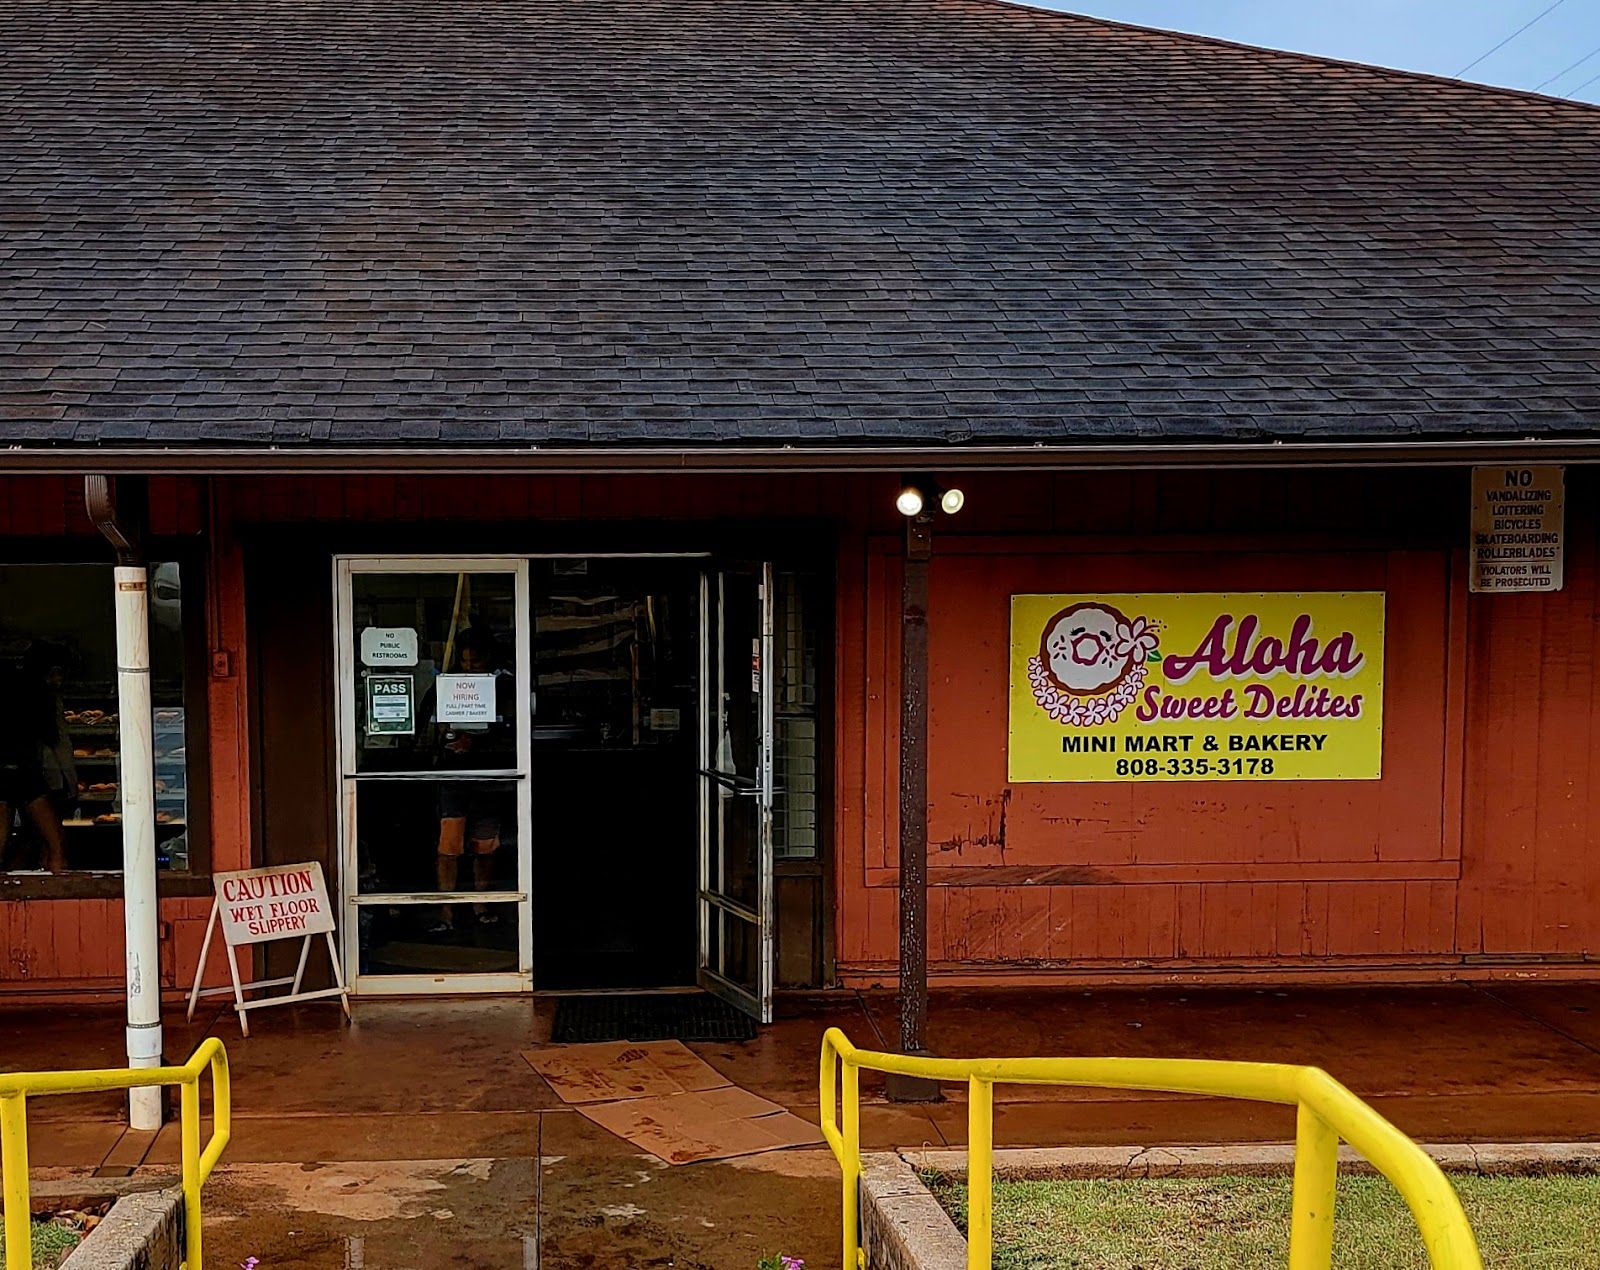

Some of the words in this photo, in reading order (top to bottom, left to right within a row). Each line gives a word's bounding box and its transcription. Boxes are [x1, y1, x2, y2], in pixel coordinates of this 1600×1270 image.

[1505, 469, 1533, 487] NO
[1486, 490, 1552, 502] VANDALIZING
[1492, 505, 1544, 516] LOITERING
[1494, 519, 1541, 530] BICYCLES
[1475, 533, 1559, 545] SKATEBOARDING
[1477, 547, 1556, 559] ROLLERBLADES
[1480, 565, 1528, 576] VIOLATORS
[1531, 565, 1552, 575] WILL
[1480, 578, 1492, 588] BE
[1495, 577, 1551, 587] PROSECUTED
[1162, 613, 1365, 680] Aloha
[374, 683, 407, 694] PASS
[453, 693, 480, 701] HIRING
[1136, 685, 1239, 722] Sweet
[1243, 683, 1363, 720] Delites
[1062, 735, 1116, 753] MINI
[1124, 735, 1194, 752] MART
[1202, 735, 1220, 752] &
[1228, 734, 1328, 752] BAKERY
[1115, 758, 1275, 776] 808-335-3178
[223, 870, 315, 902] CAUTION
[230, 905, 264, 923] WET
[269, 898, 320, 918] FLOOR
[248, 915, 307, 935] SLIPPERY
